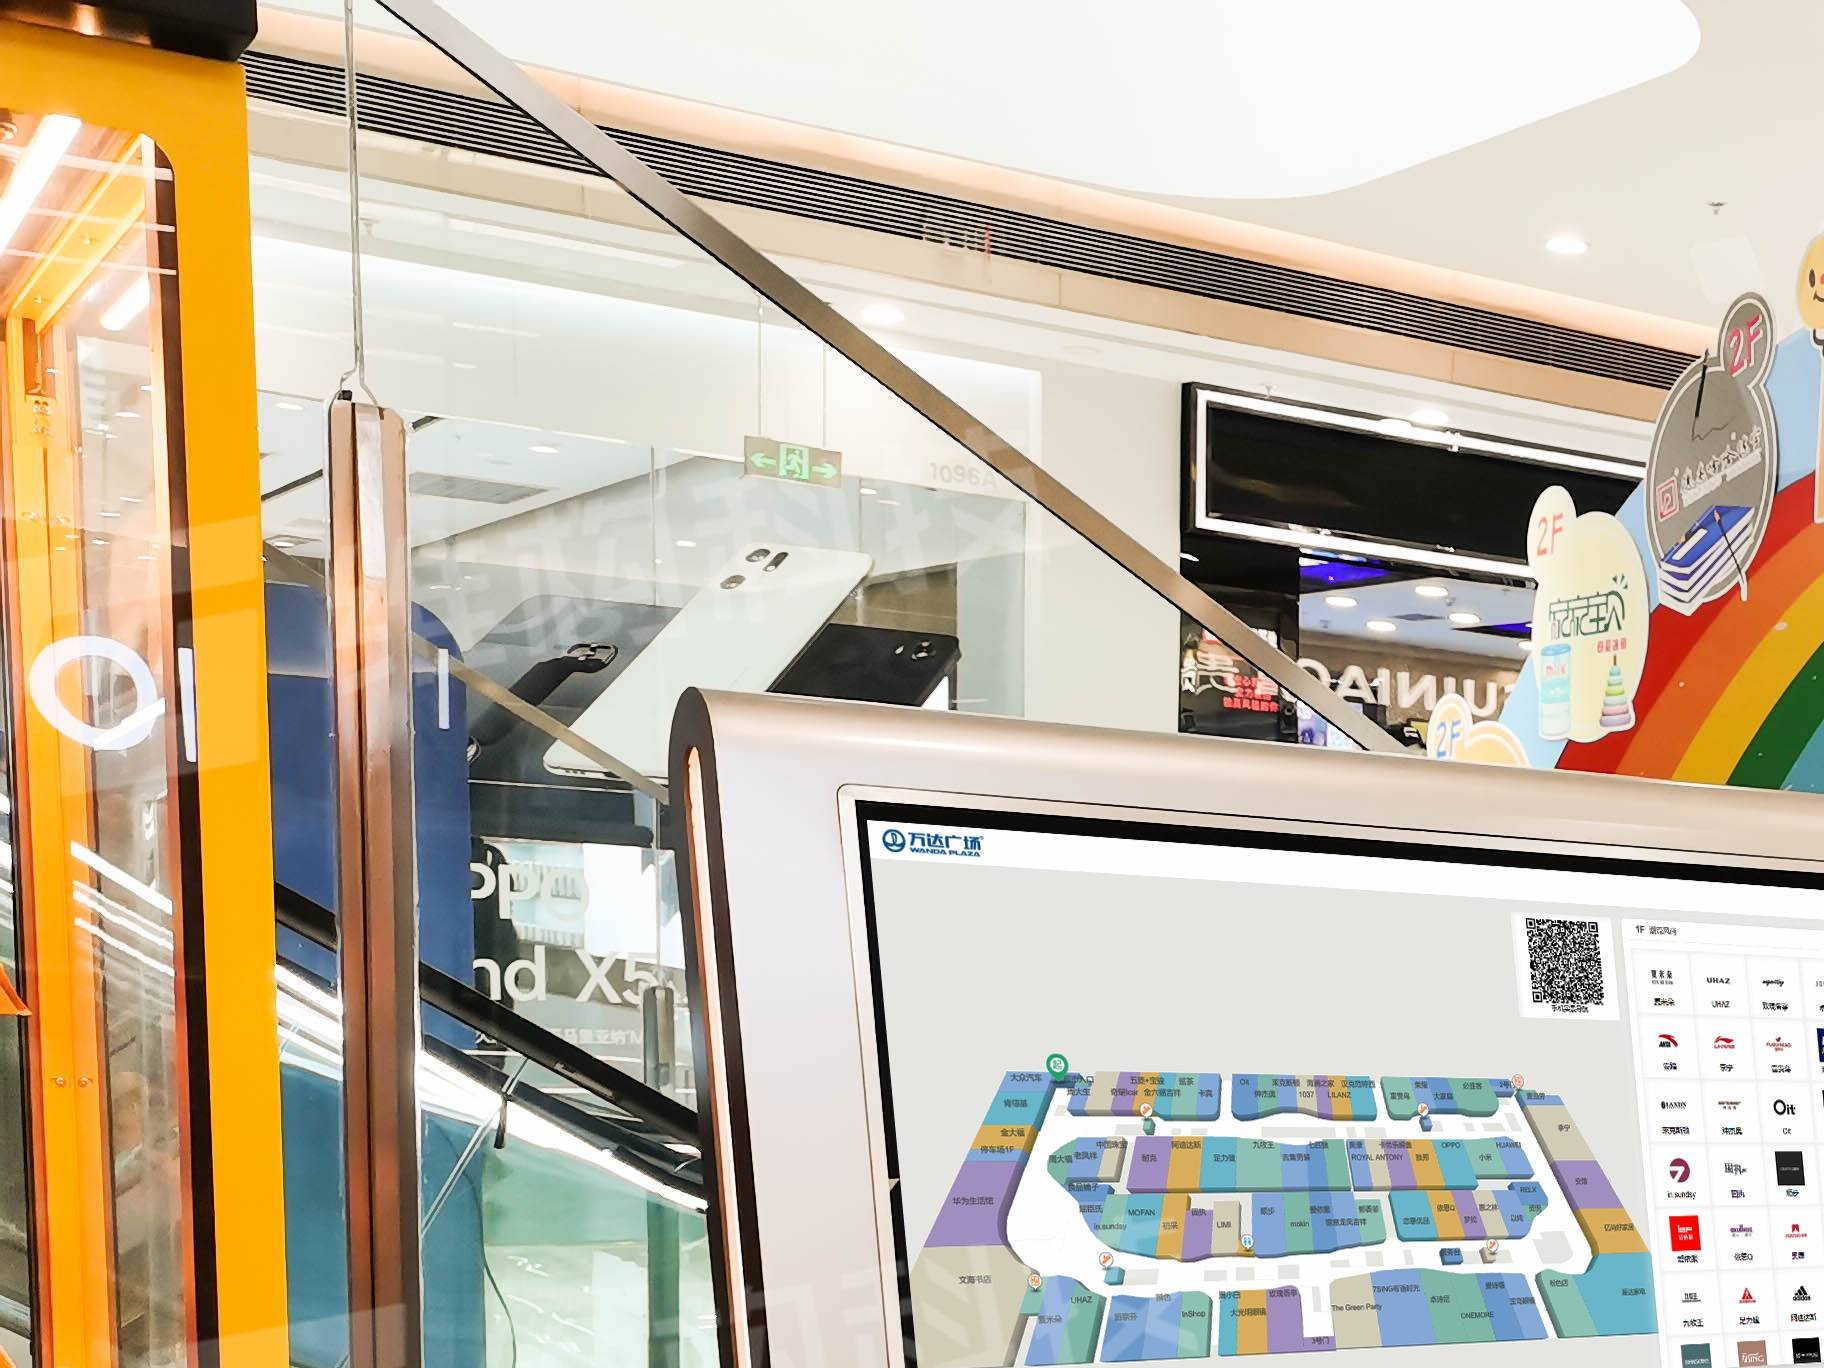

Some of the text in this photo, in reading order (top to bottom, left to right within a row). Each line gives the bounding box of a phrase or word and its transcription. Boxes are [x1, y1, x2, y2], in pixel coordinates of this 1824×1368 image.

[1728, 314, 1763, 377] 2F
[1537, 514, 1565, 556] 2F
[1436, 719, 1461, 758] 2F
[908, 832, 980, 850] 万达广场
[1635, 925, 1645, 934] 1F
[1299, 1091, 1314, 1099] 1037
[1328, 1091, 1351, 1099] LILANZ
[1773, 1099, 1795, 1115] Oit
[1442, 1141, 1460, 1149] OPPO
[1496, 1141, 1521, 1149] HUAWEI
[1217, 1221, 1232, 1229] LIMI
[1071, 1296, 1092, 1304] UHAZ
[1332, 1302, 1382, 1312] The Green Party
[1460, 1310, 1495, 1319] ONEMORE
